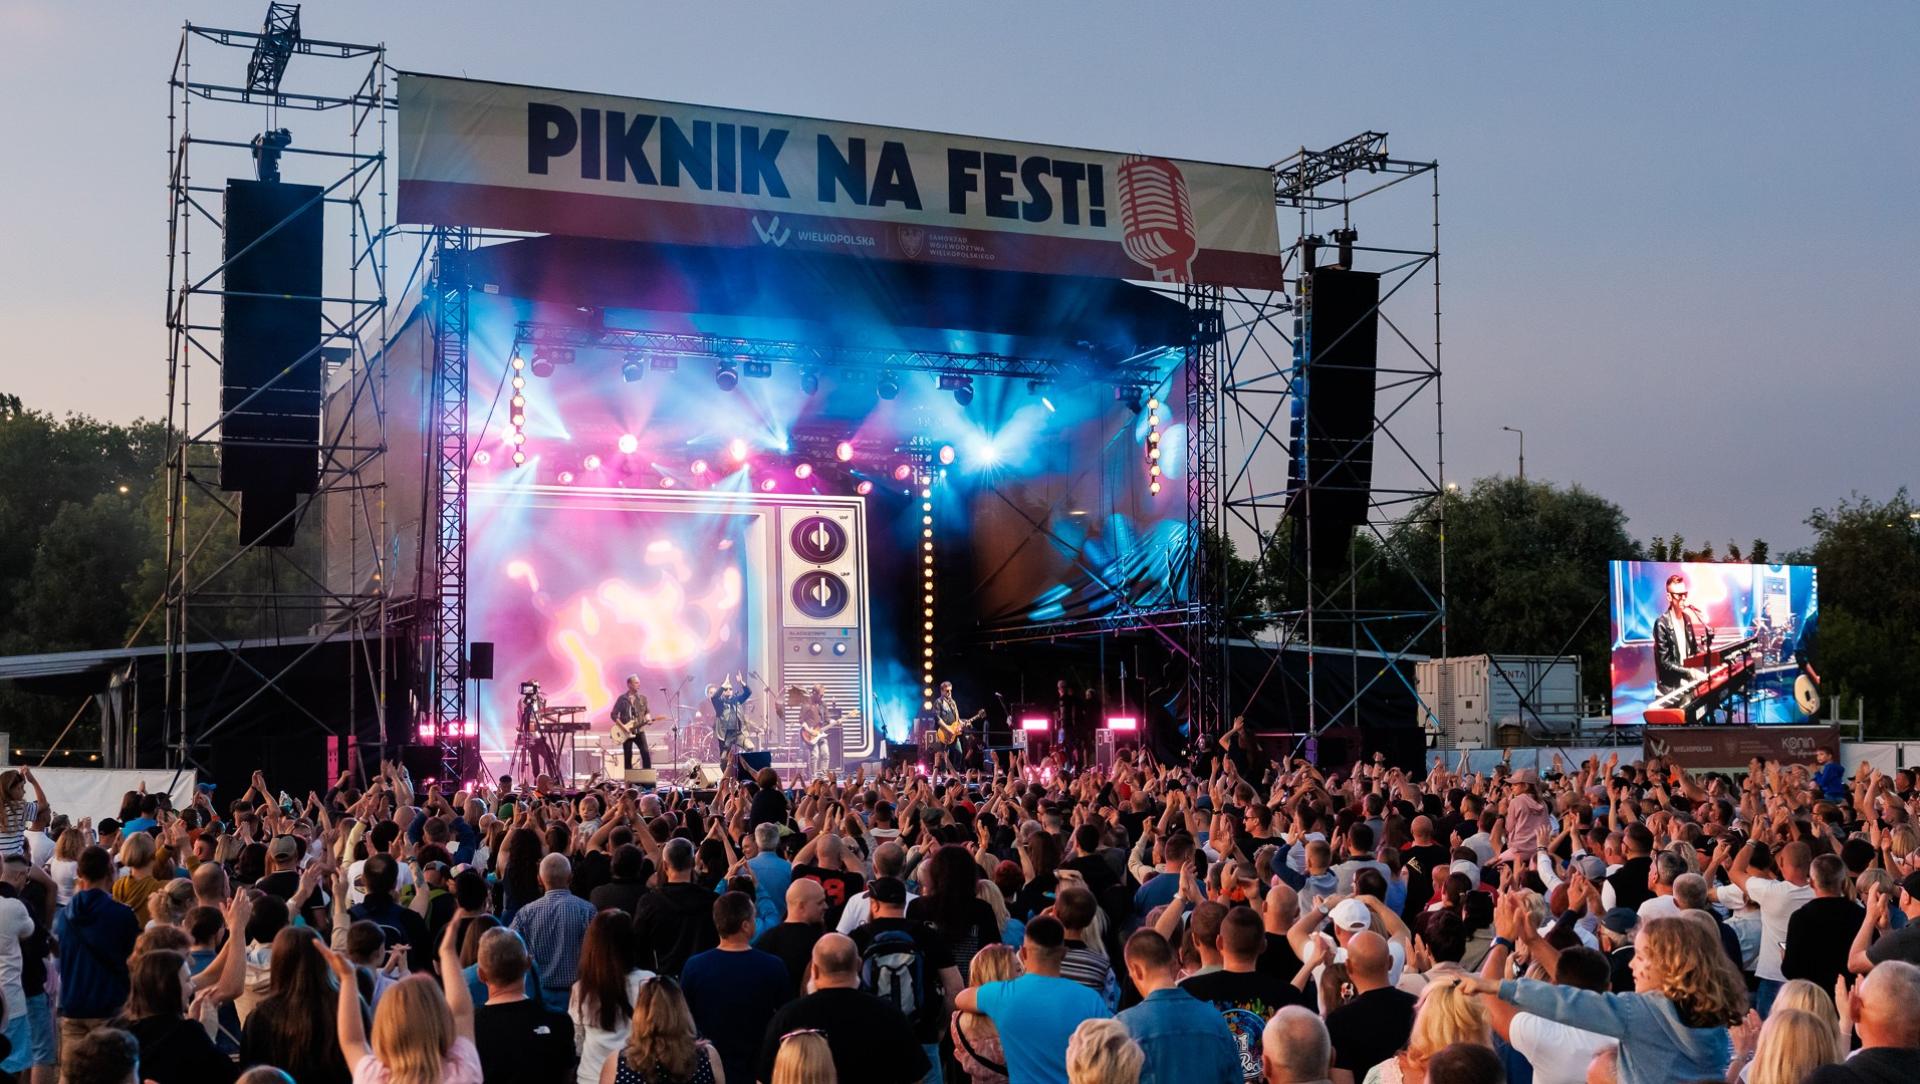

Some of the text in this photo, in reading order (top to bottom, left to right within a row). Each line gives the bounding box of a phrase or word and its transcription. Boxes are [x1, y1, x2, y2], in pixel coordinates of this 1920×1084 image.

[528, 102, 1107, 228] PIKNIK NA FEST!
[798, 231, 876, 246] WIELKOPOLSKA
